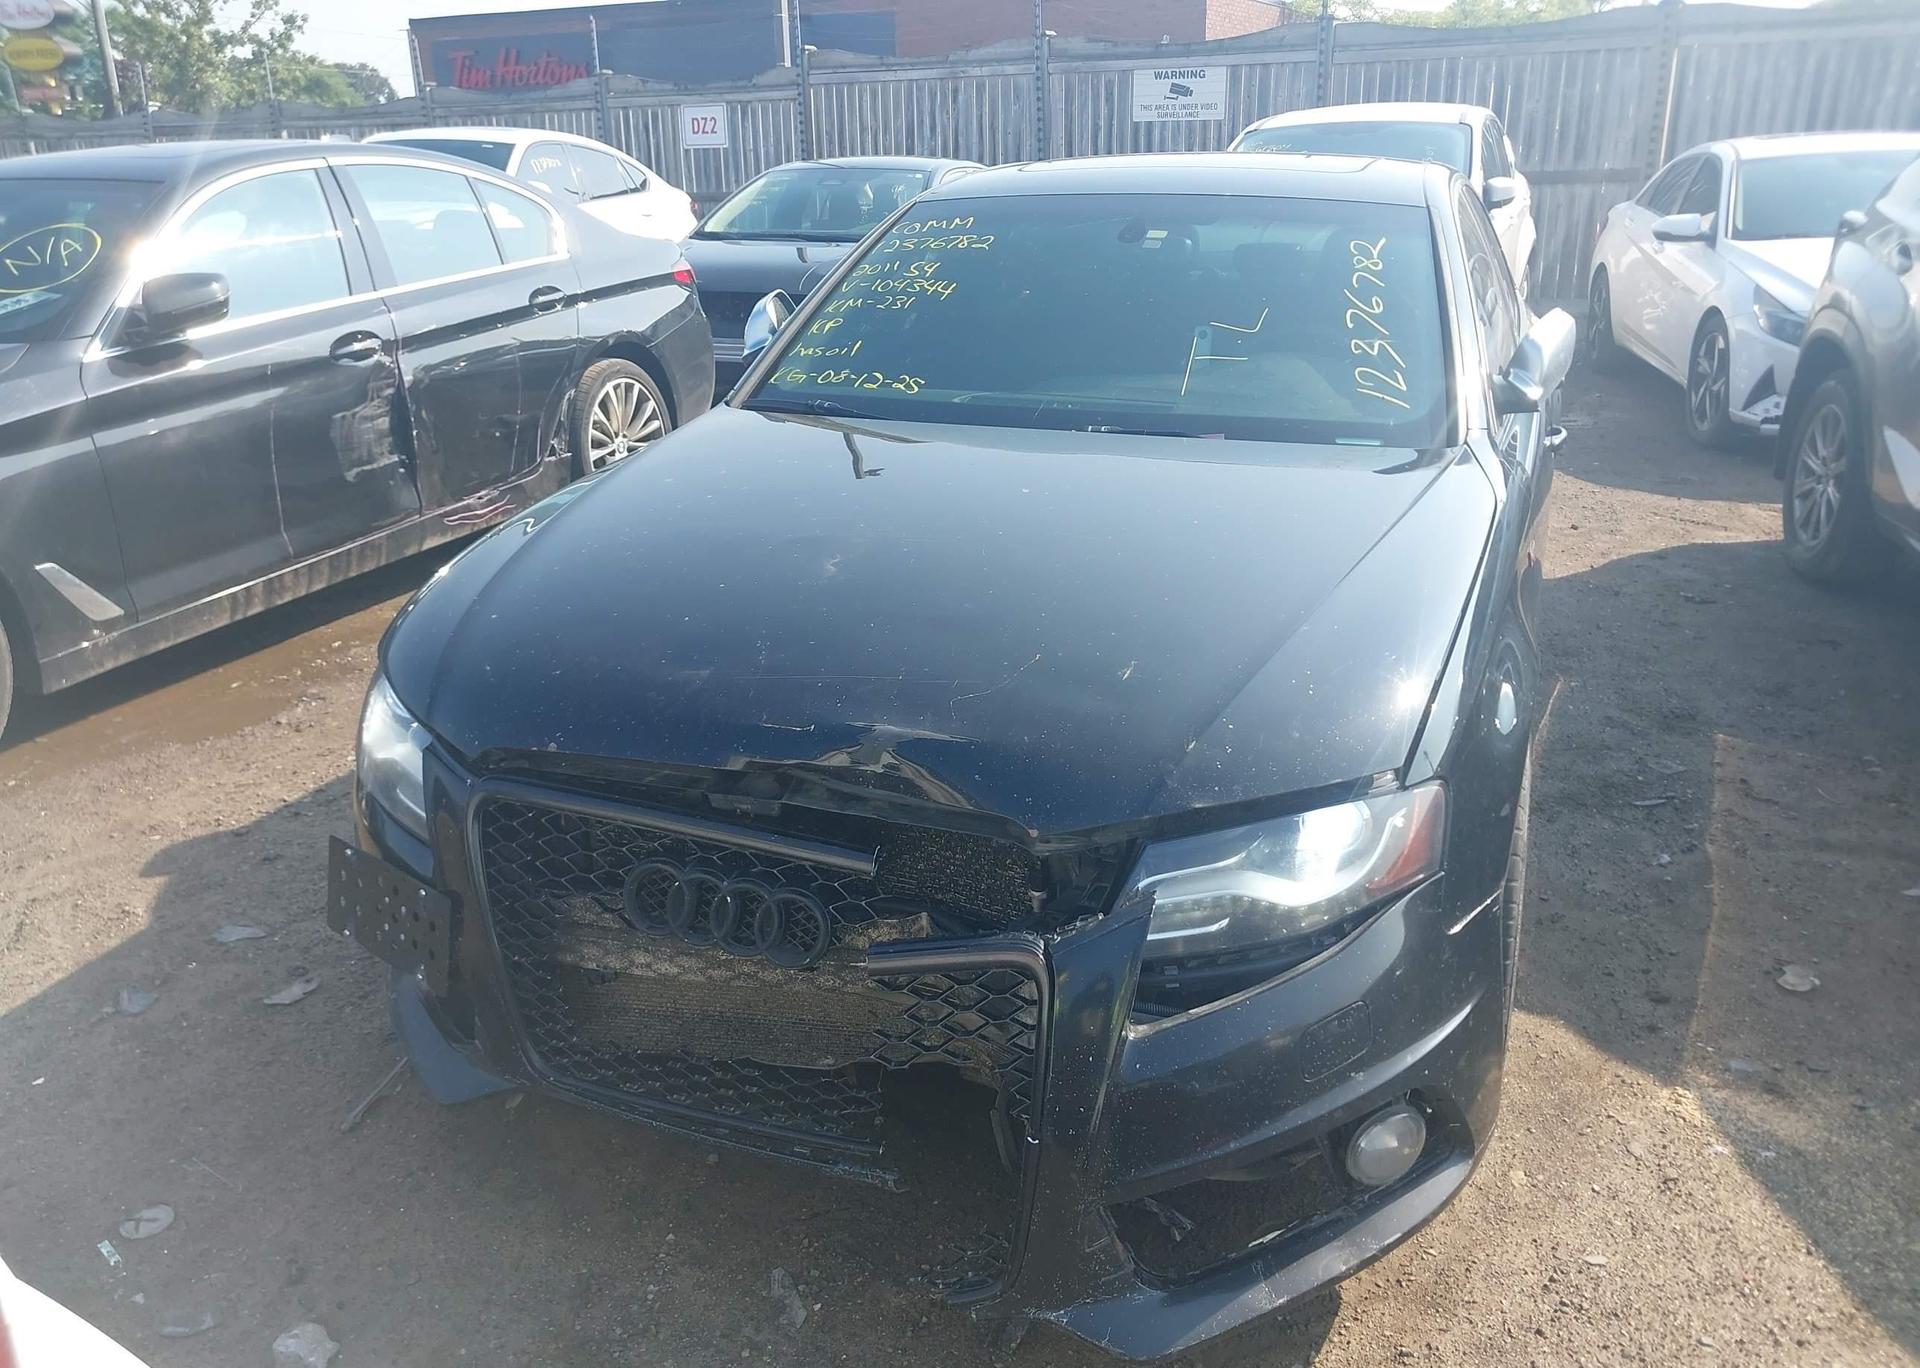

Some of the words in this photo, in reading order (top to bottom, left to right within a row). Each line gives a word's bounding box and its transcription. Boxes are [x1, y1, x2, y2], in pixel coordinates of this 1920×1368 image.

[448, 49, 492, 89] Tim
[496, 47, 588, 86] Hortons
[1153, 69, 1206, 80] WARNING
[1140, 104, 1153, 112] THIS
[1179, 103, 1199, 111] UNDER
[1200, 102, 1218, 110] VIDEO
[1156, 110, 1200, 119] SURVEILLANCE
[691, 116, 718, 135] DZ2
[892, 216, 974, 234] COMM
[871, 235, 994, 255] 12376782
[5, 236, 82, 276] N/A
[852, 261, 900, 277] 2011
[824, 295, 916, 313] KM-231
[1344, 237, 1410, 408] 12376782
